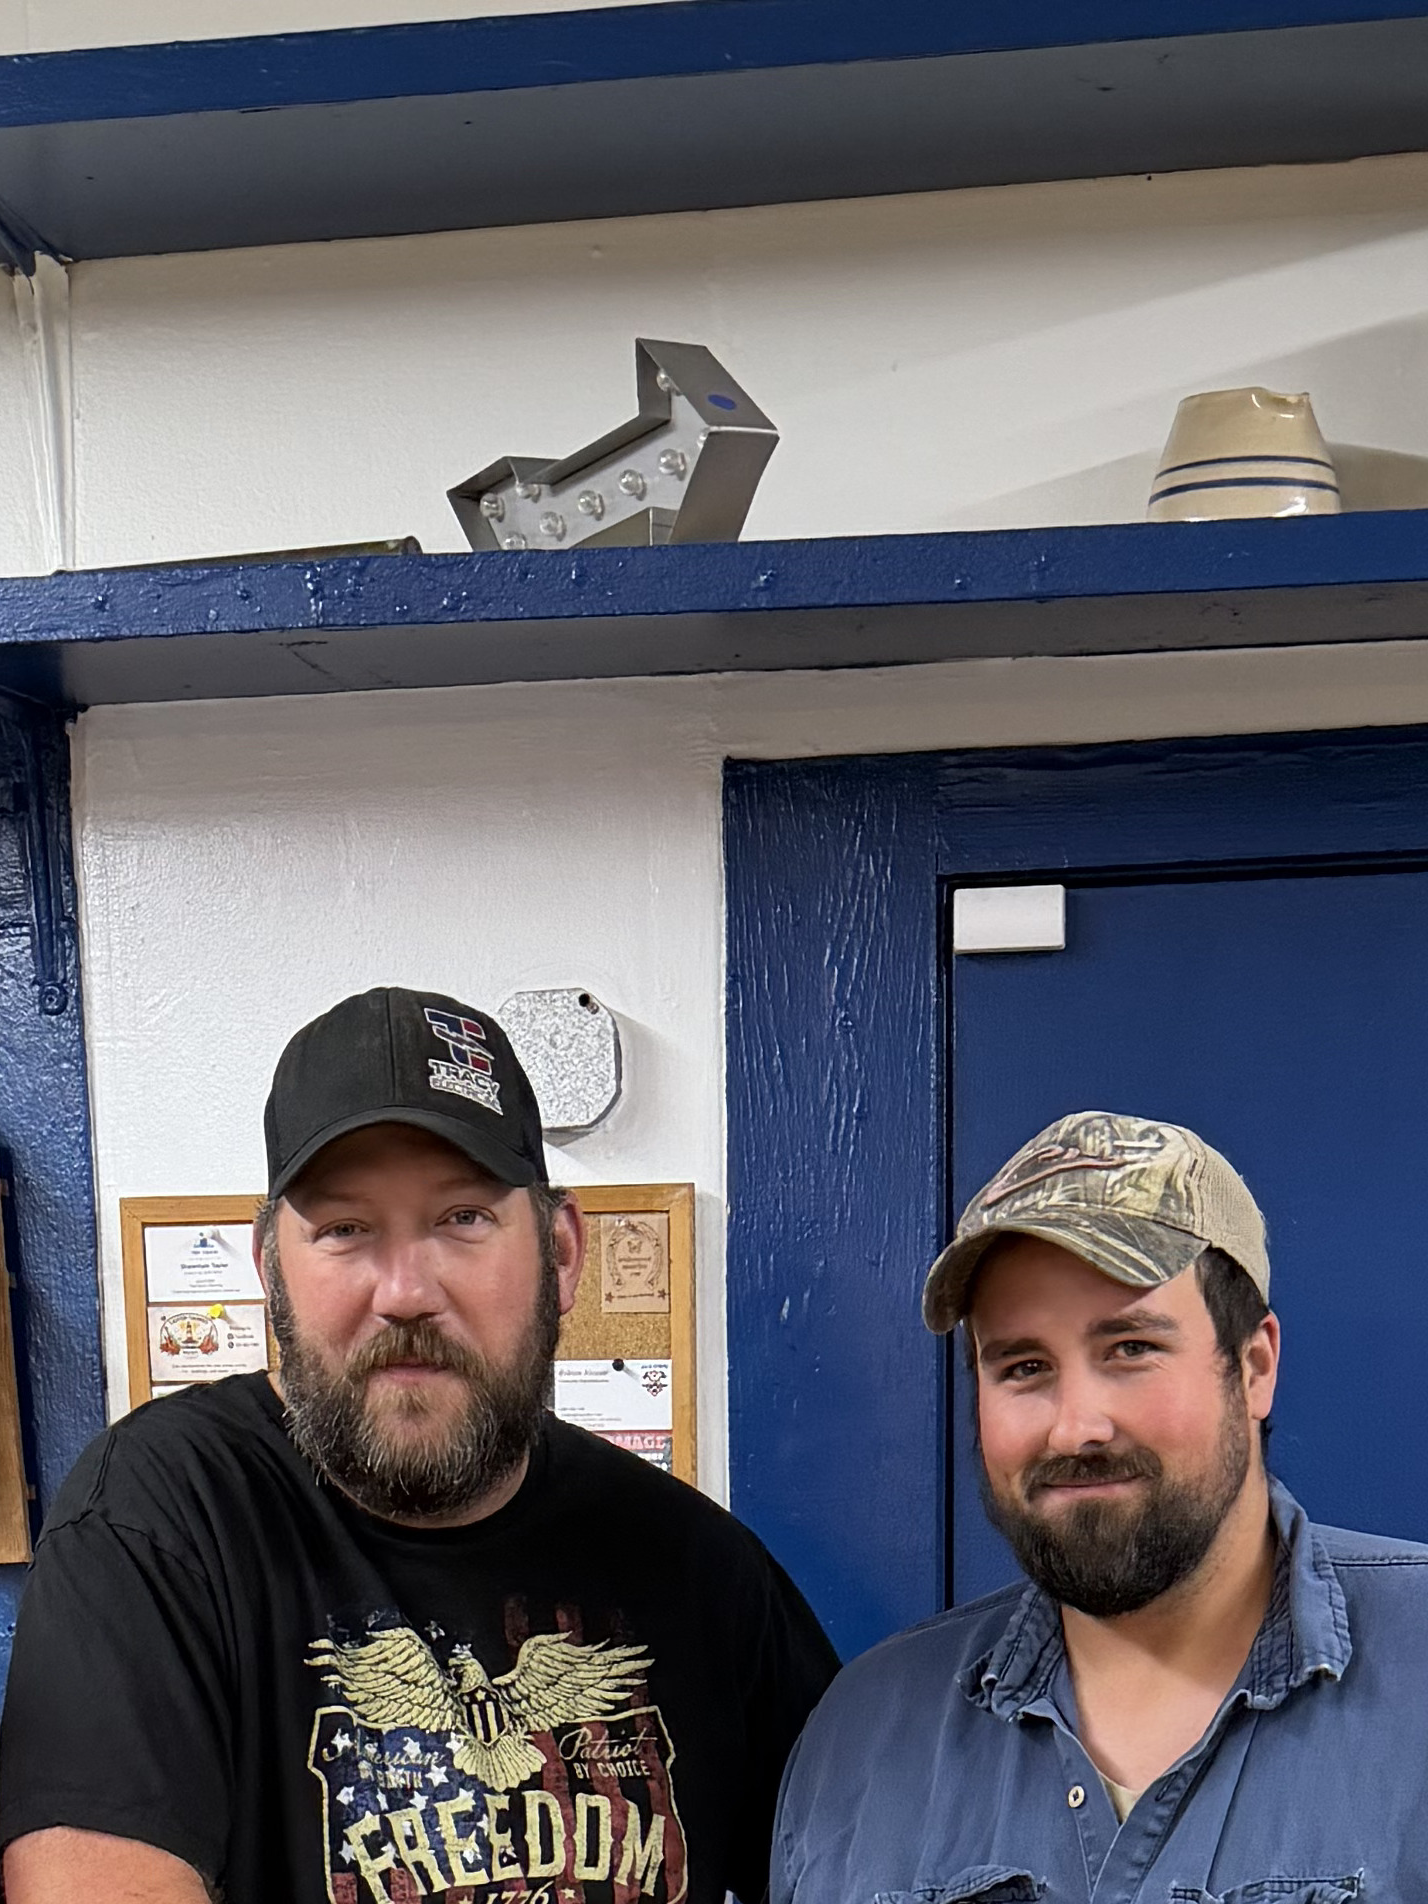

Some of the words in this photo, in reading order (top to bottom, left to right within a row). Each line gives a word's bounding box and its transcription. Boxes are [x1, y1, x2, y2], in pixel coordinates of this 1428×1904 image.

[428, 1059, 500, 1096] TRACY
[559, 1728, 658, 1761] Patriot
[575, 1764, 590, 1779] BY
[598, 1760, 651, 1778] CHOICE
